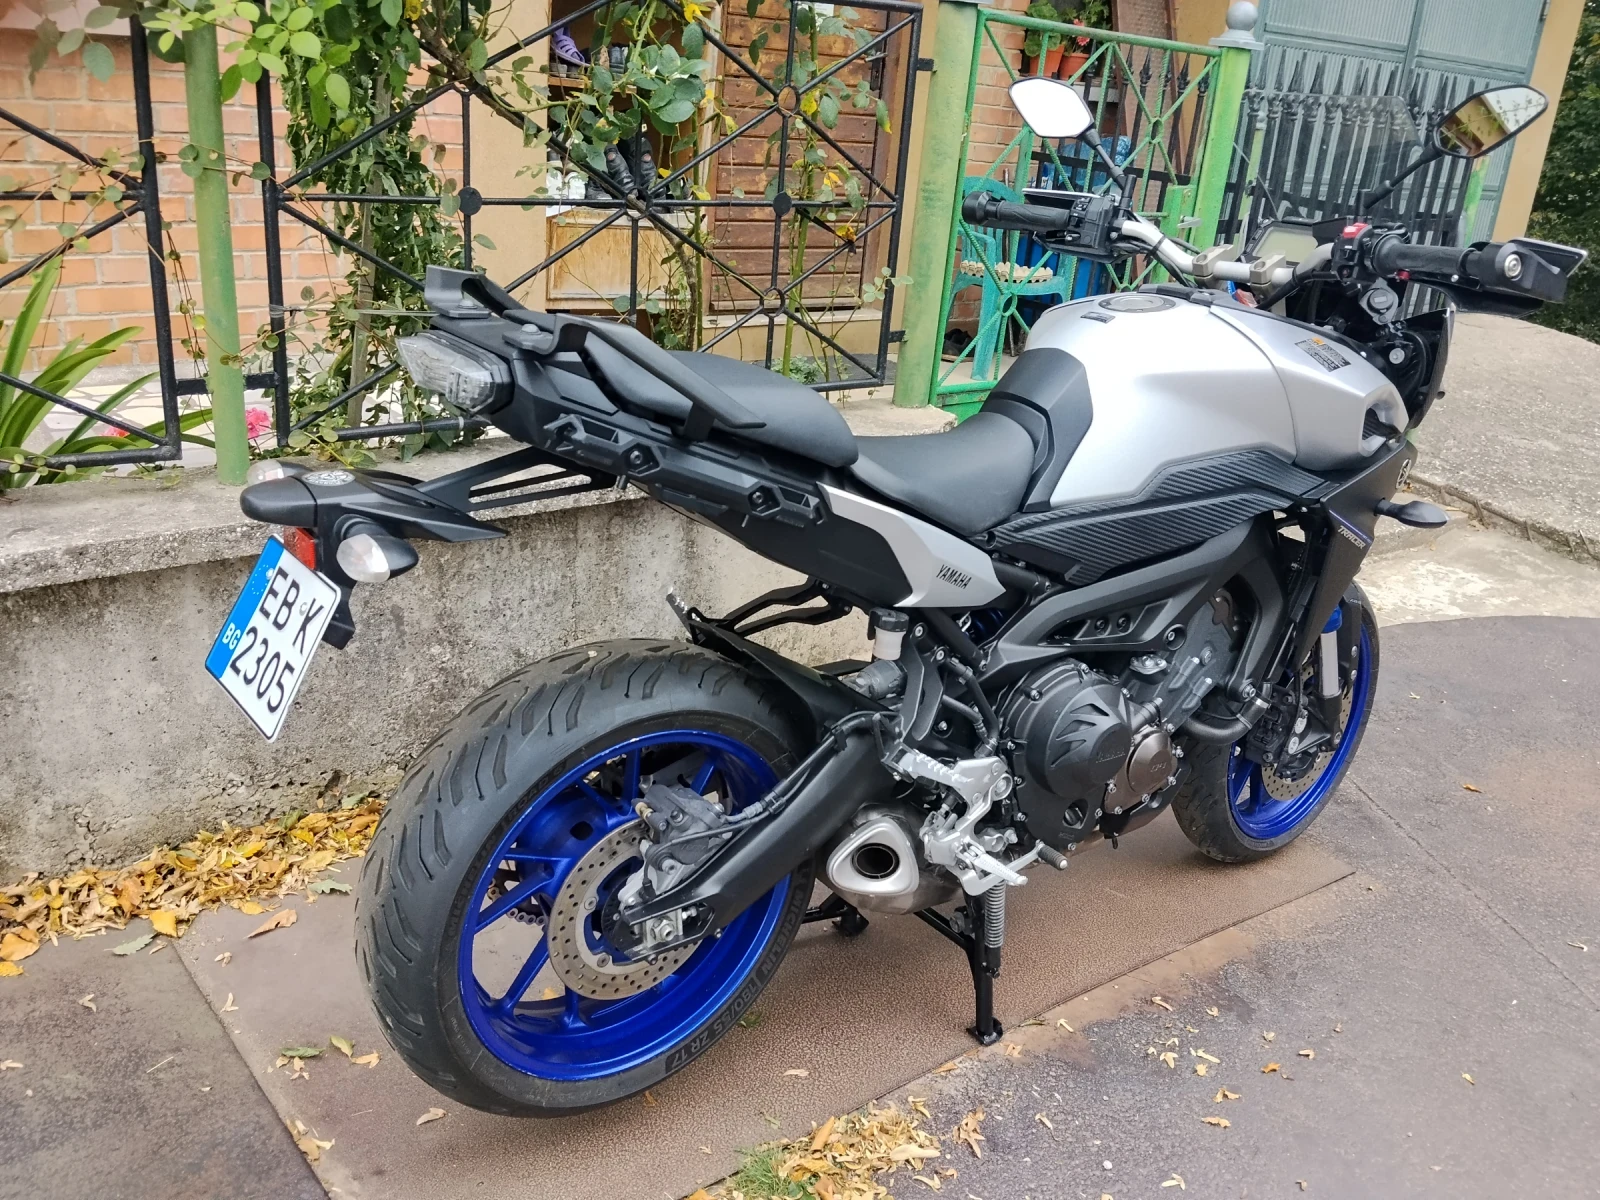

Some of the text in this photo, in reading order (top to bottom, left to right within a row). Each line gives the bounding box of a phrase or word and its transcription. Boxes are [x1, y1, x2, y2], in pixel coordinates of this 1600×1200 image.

[1337, 525, 1366, 550] TRACER
[936, 564, 972, 589] YAMAHA
[222, 622, 242, 650] BG
[230, 626, 295, 713] 2305
[672, 889, 805, 1067] MICHELIN 180/55 ZR 17
